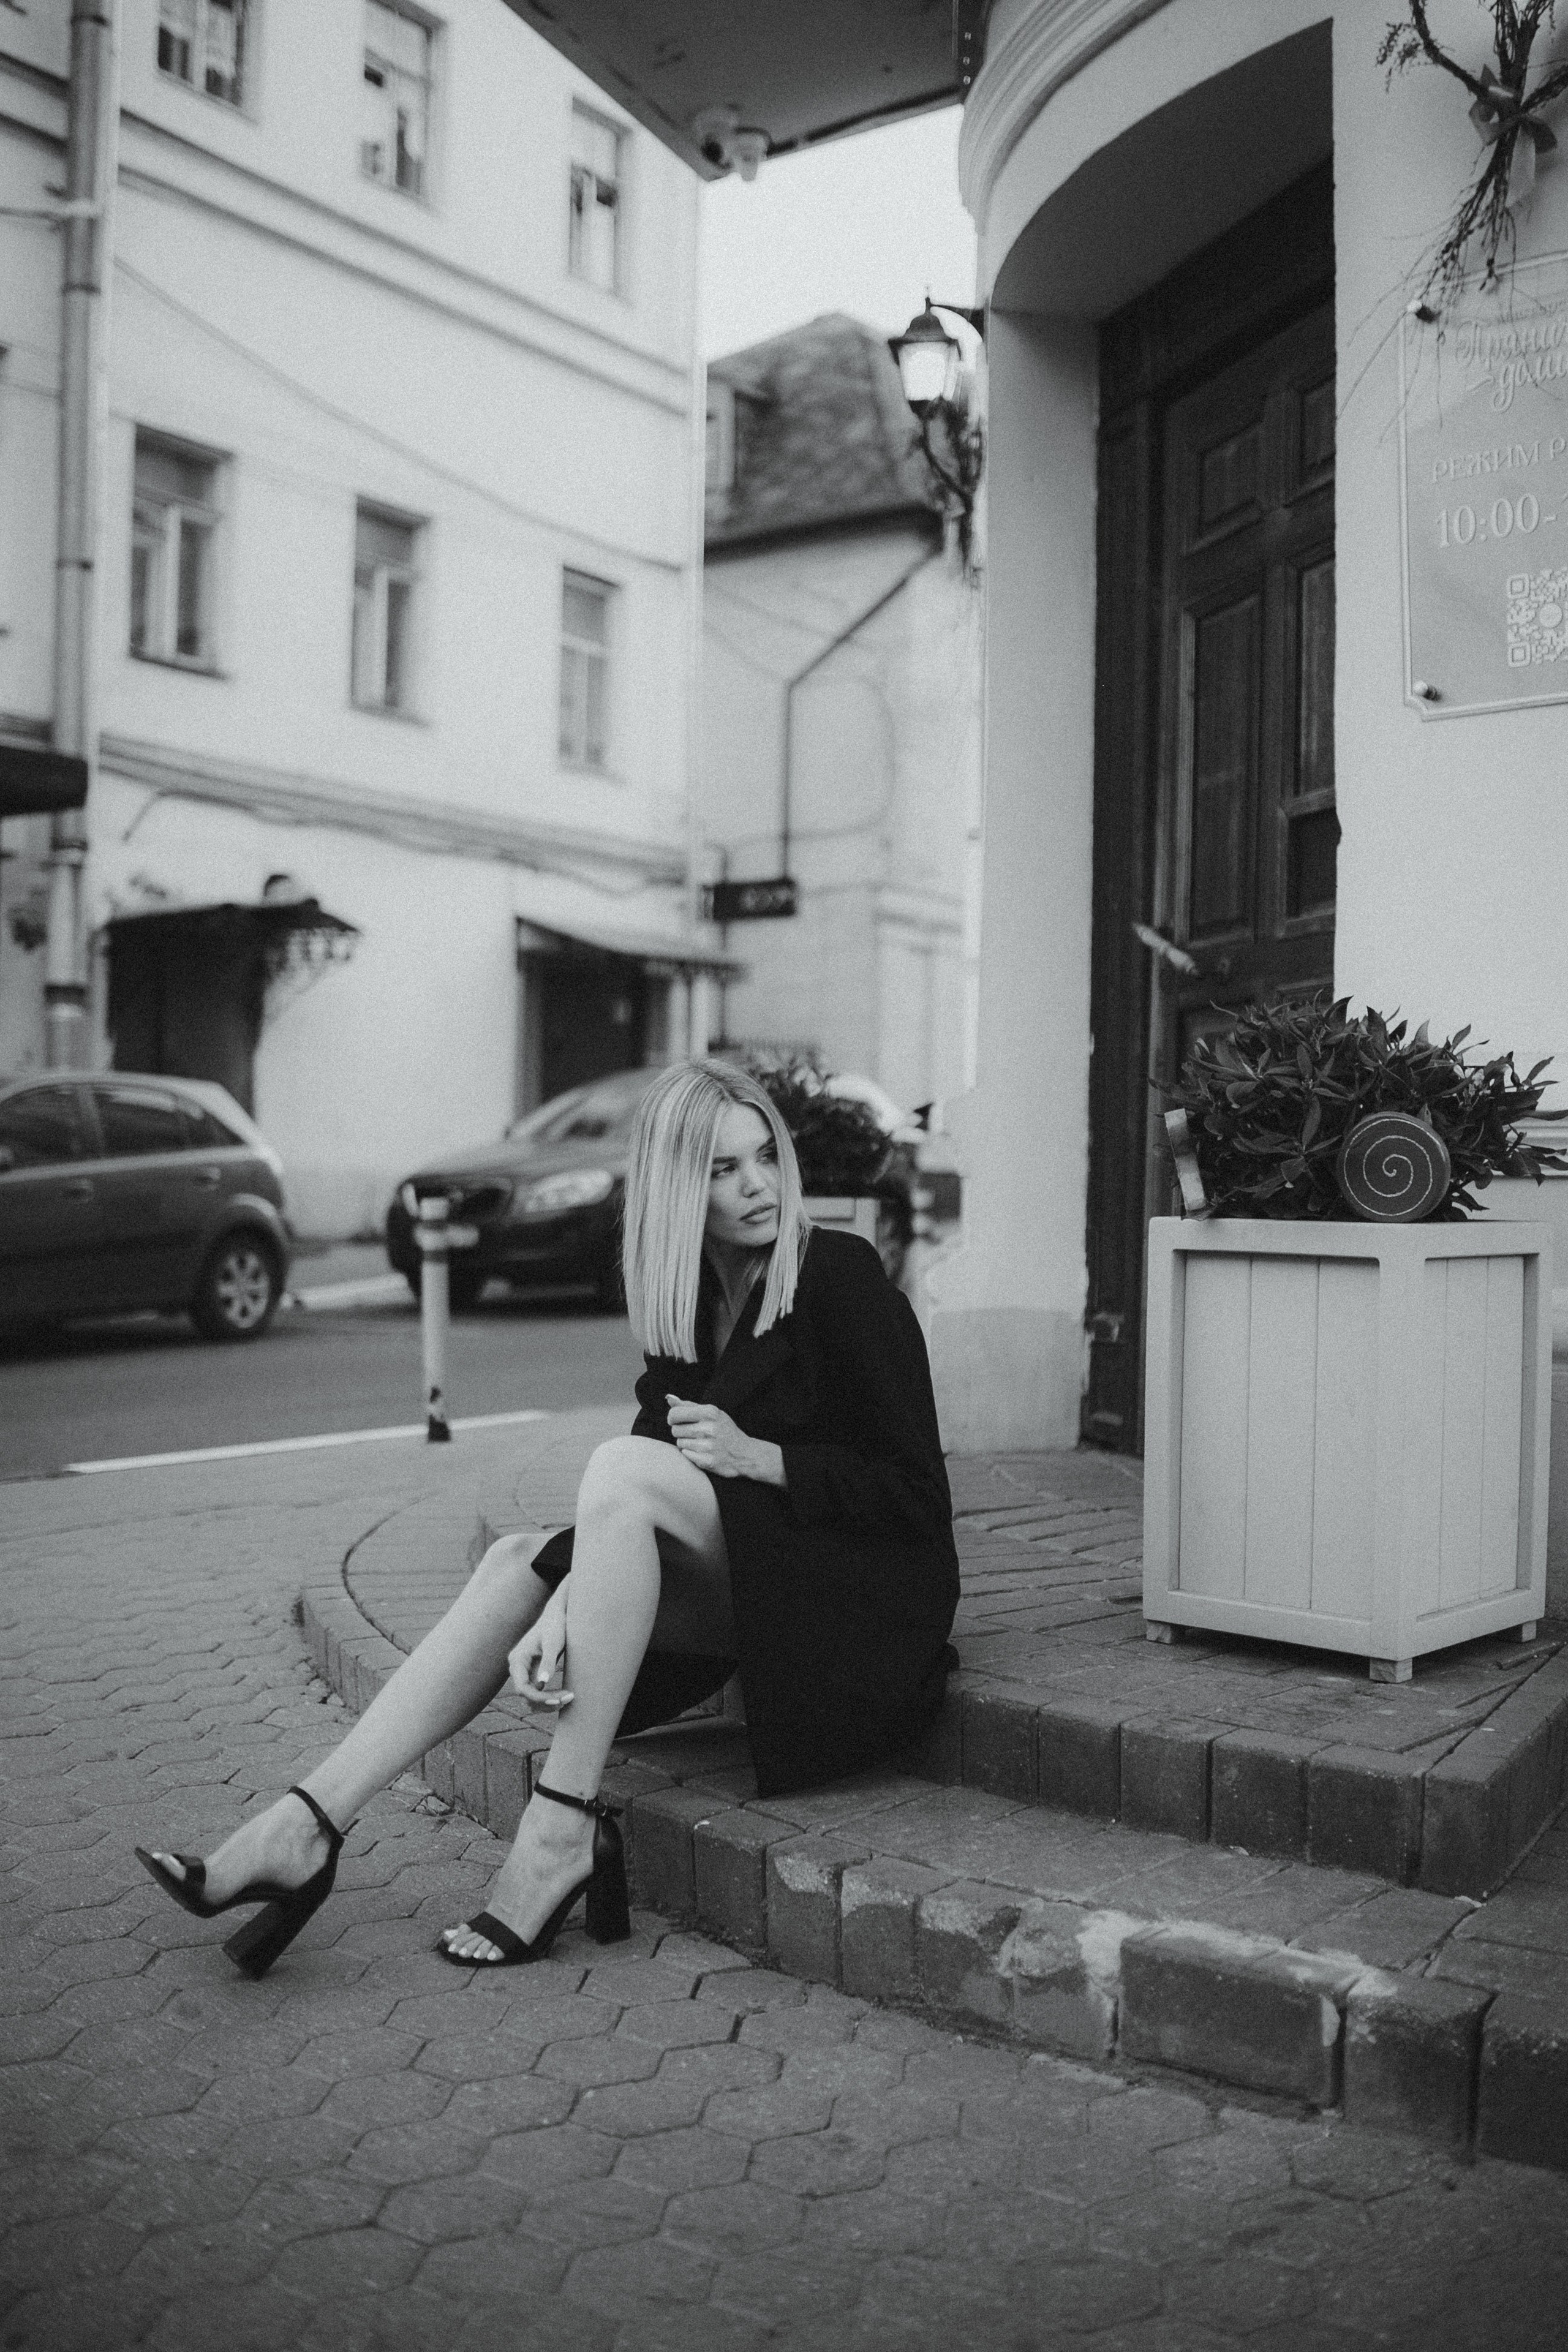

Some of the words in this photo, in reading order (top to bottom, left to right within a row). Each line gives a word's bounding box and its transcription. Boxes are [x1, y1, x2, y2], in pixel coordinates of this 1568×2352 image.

[1455, 316, 1568, 371] Пряни
[1431, 440, 1541, 484] РЕЖИМ
[1434, 492, 1568, 549] 10:00-
